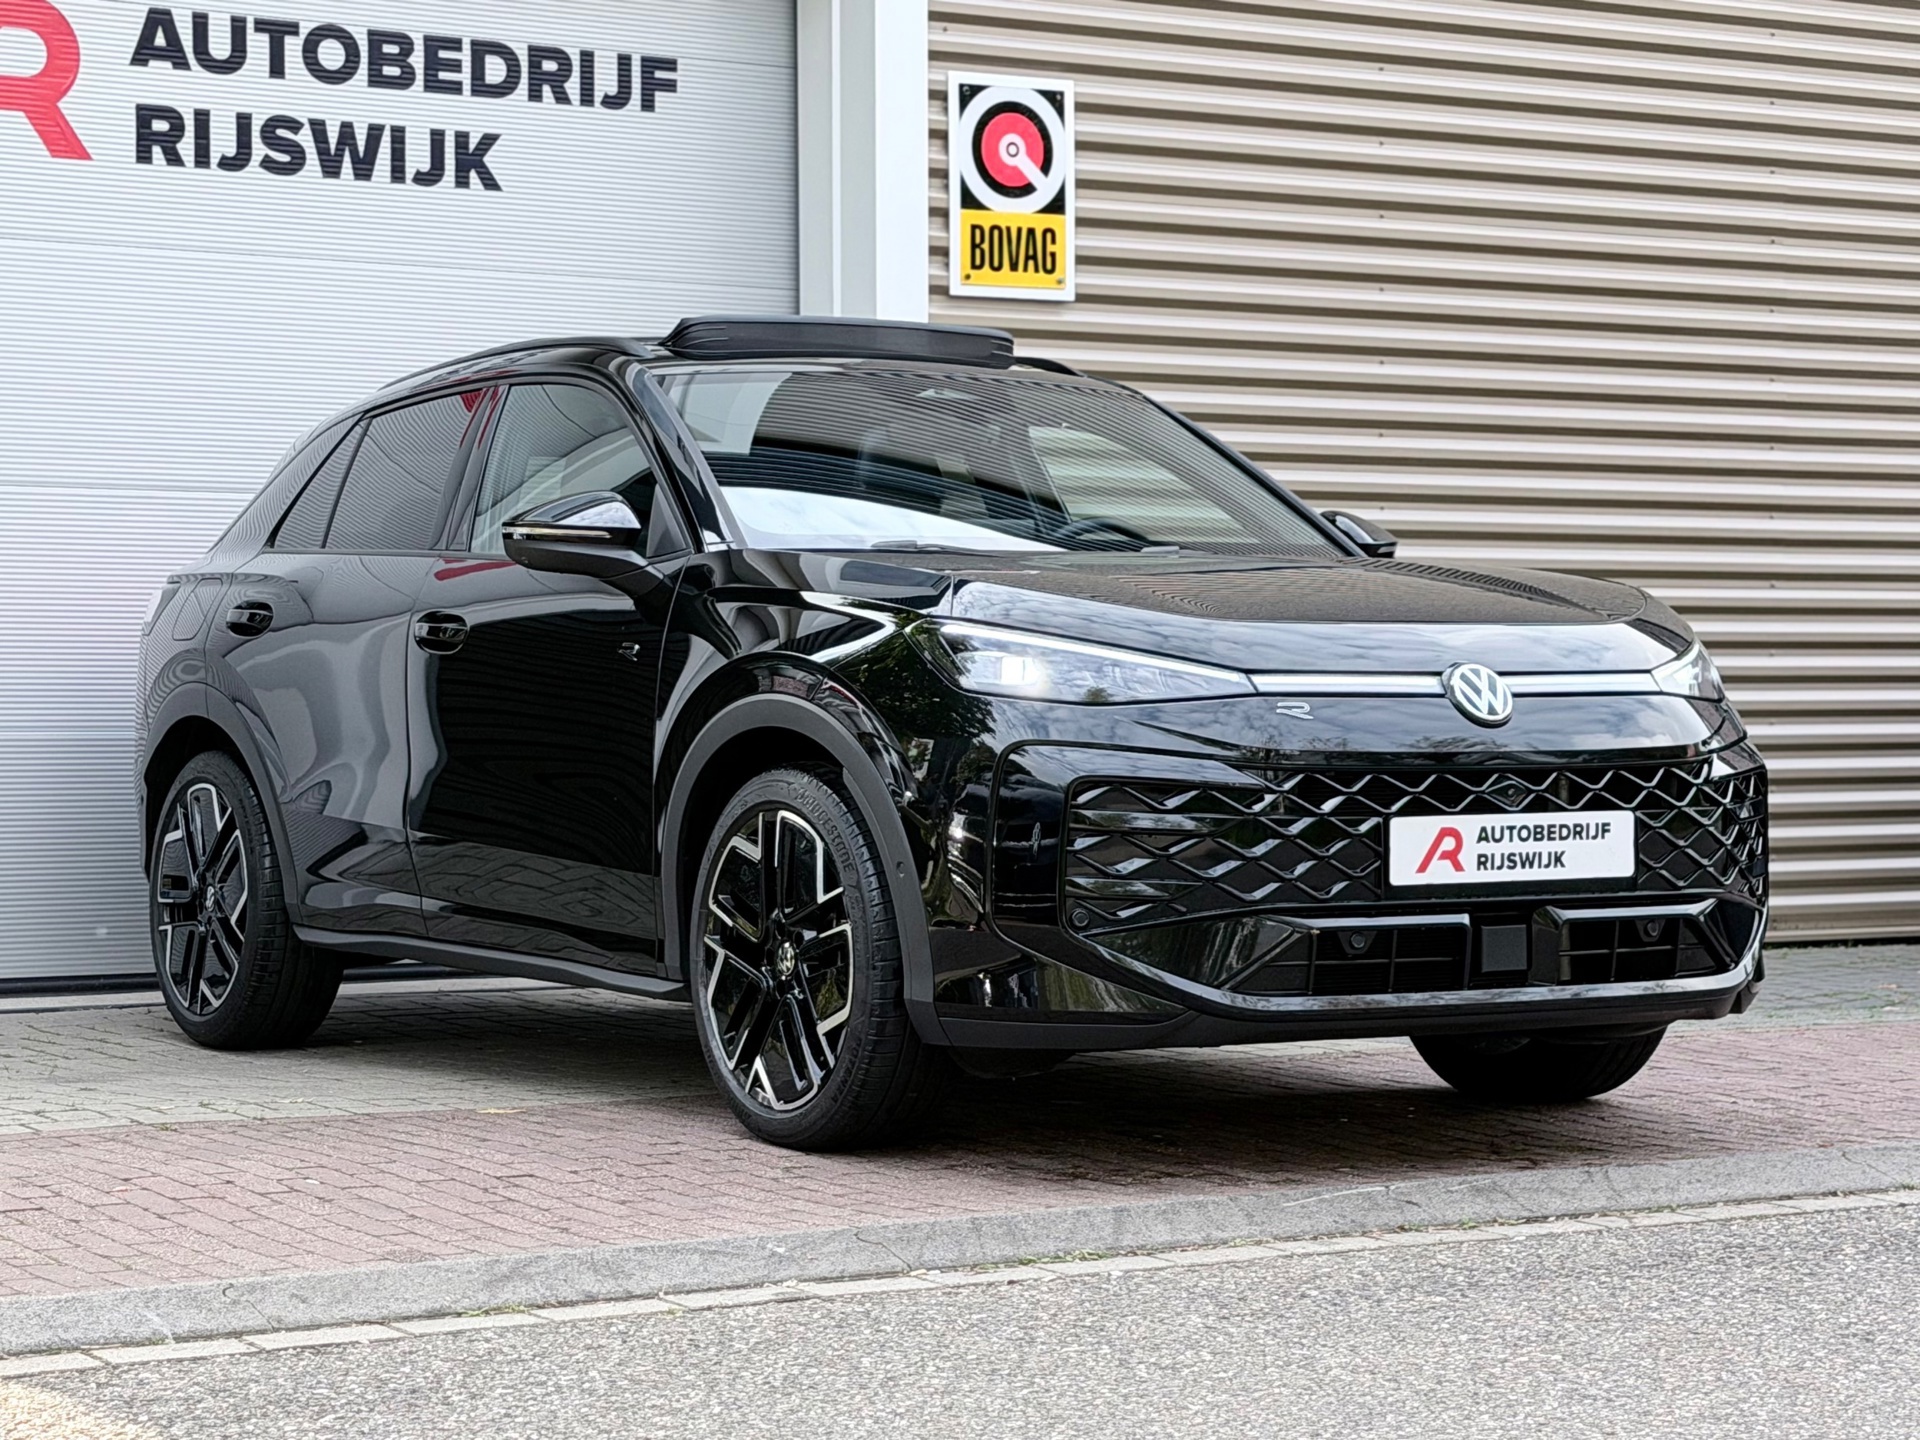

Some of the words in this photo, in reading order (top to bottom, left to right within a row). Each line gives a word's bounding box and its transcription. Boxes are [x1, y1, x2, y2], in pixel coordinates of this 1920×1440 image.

[129, 7, 678, 113] AUTOBEDRIJF
[135, 103, 502, 192] RIJSWIJK
[970, 223, 1057, 275] BOVAG
[1476, 822, 1612, 844] AUTOBEDRIJF
[1476, 850, 1567, 871] RIJSWIJK
